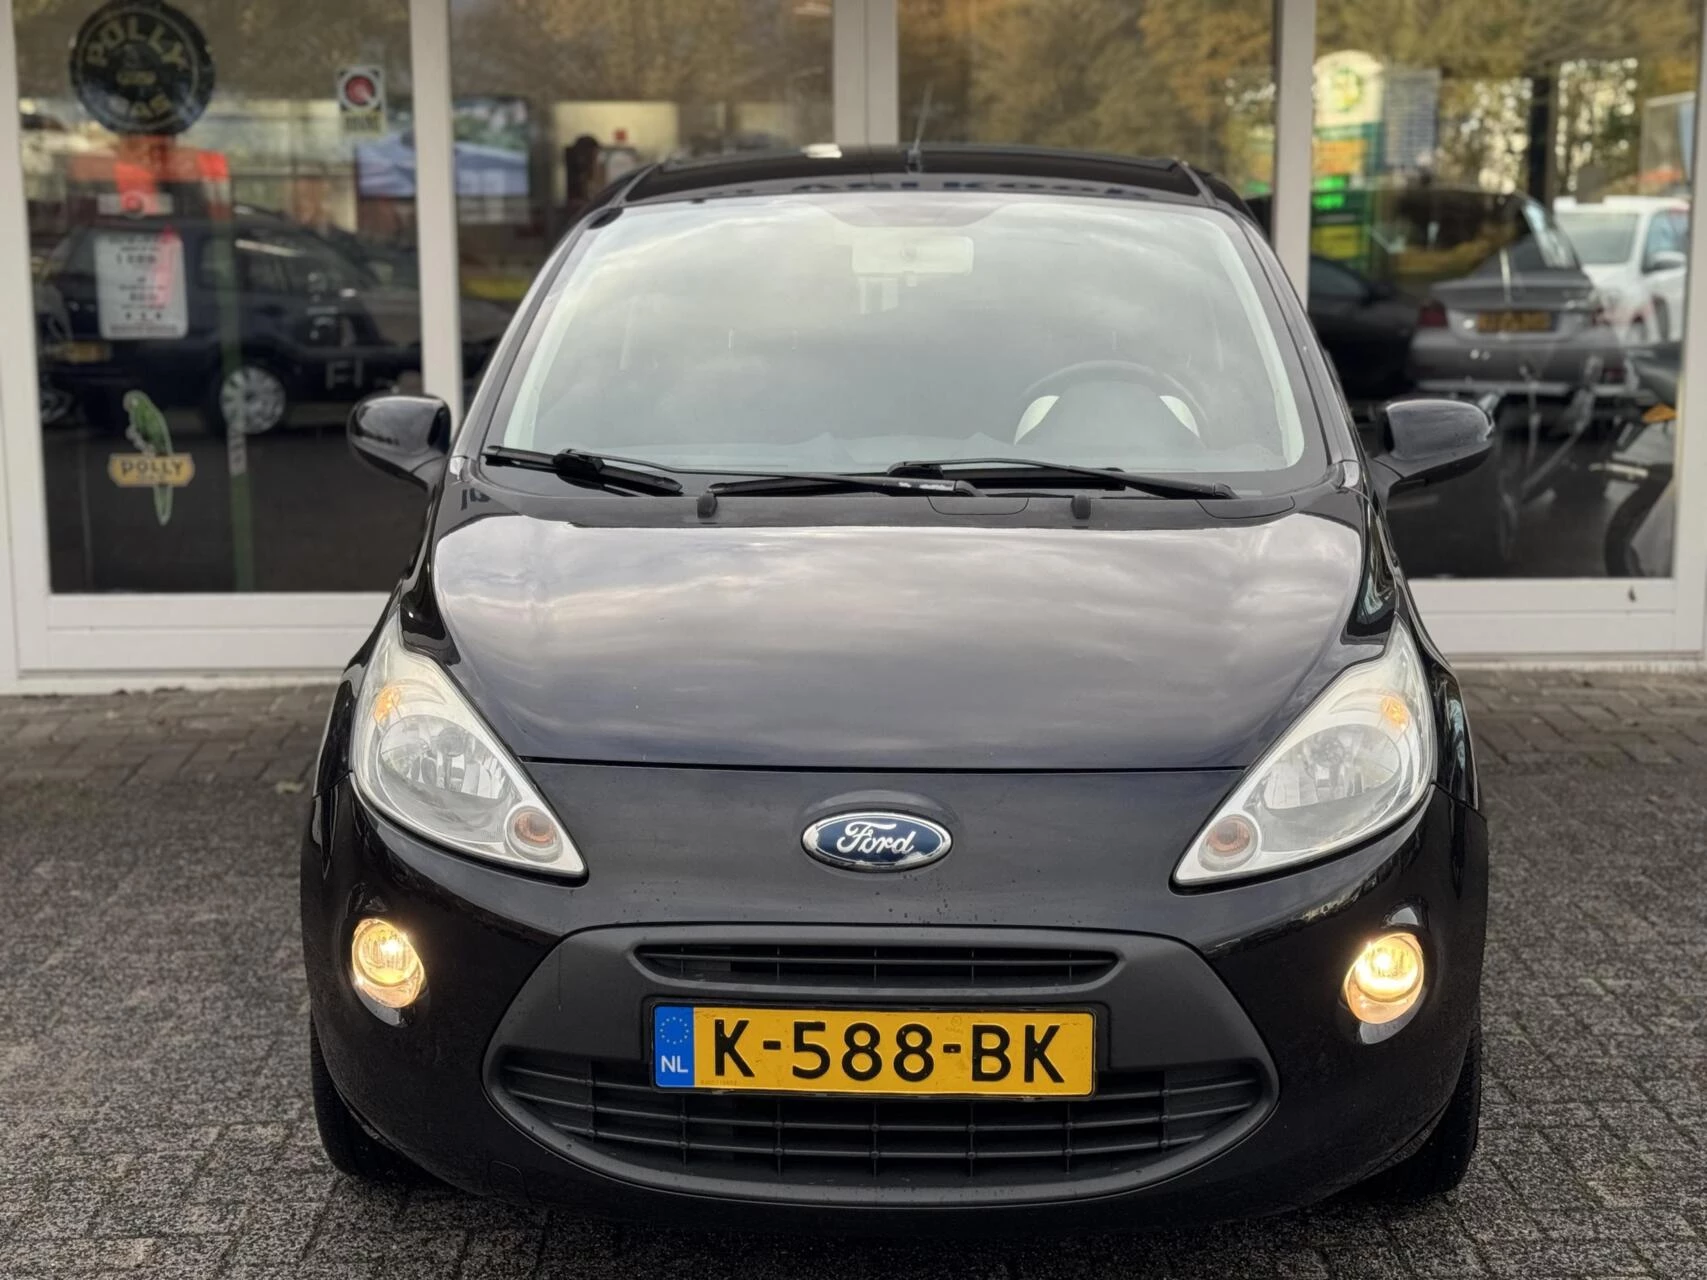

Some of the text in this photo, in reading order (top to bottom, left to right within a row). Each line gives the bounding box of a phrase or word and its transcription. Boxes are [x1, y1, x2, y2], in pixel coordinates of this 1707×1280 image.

[86, 15, 188, 71] POLLY
[121, 459, 184, 476] POLLY
[836, 820, 916, 855] Ford
[660, 1054, 689, 1074] NL
[713, 1018, 1065, 1084] K-588-BK
